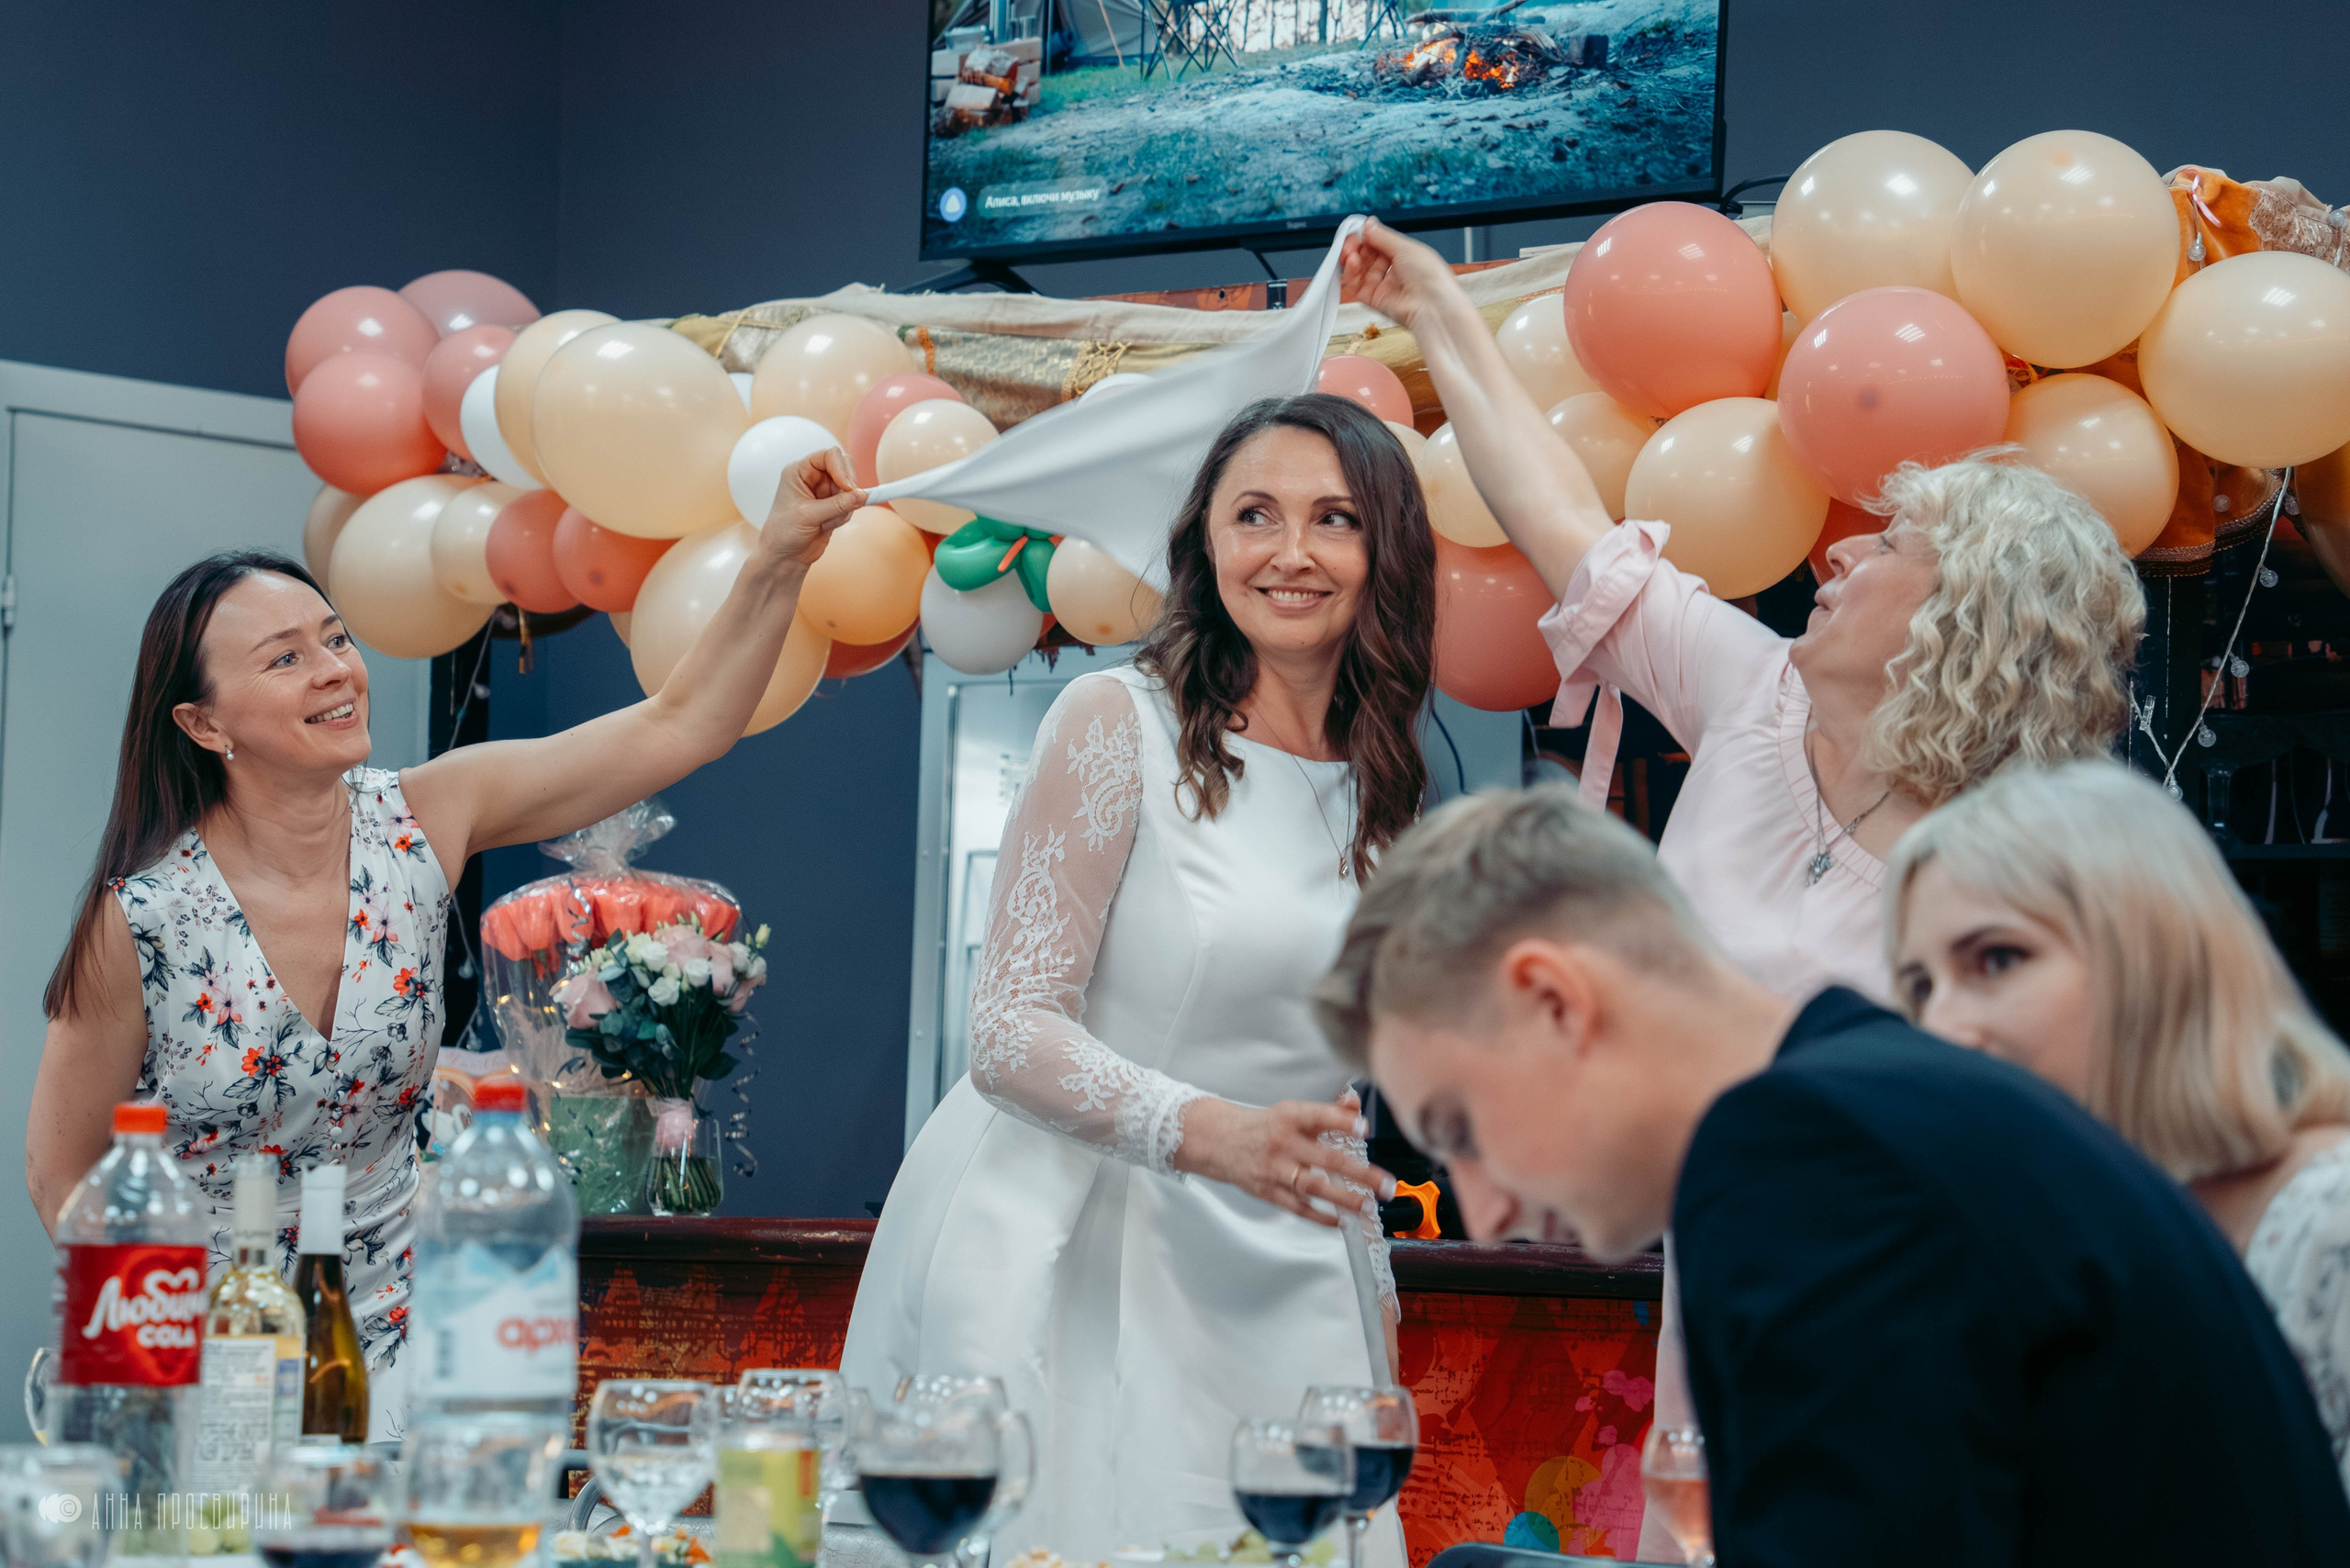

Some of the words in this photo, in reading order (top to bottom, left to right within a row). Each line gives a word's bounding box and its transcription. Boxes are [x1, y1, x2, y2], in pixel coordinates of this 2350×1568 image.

[985, 196, 1019, 208] Алиса,
[1021, 191, 1059, 205] включи
[1060, 188, 1100, 202] музыку
